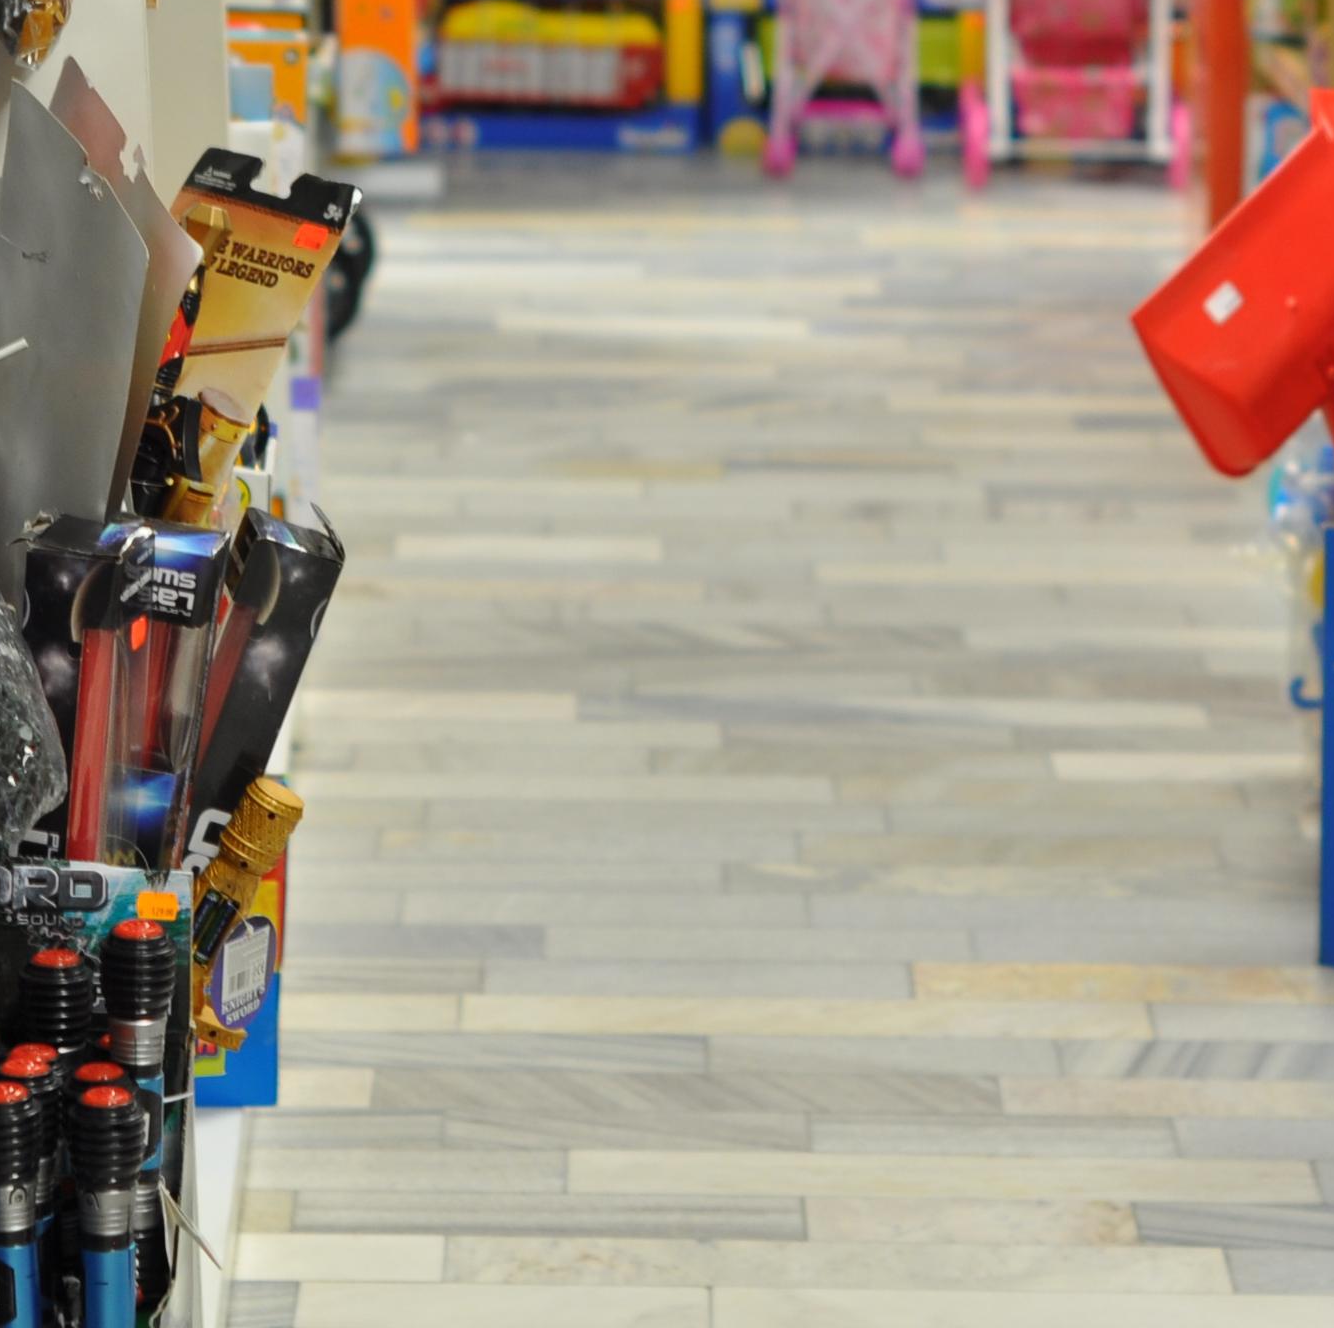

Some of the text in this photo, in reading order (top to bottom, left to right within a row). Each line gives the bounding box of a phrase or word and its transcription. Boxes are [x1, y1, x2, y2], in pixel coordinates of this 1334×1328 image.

[216, 256, 279, 289] LEGEND
[230, 241, 315, 279] WARRIORS
[17, 914, 86, 929] SOUND
[226, 999, 260, 1025] SWORD
